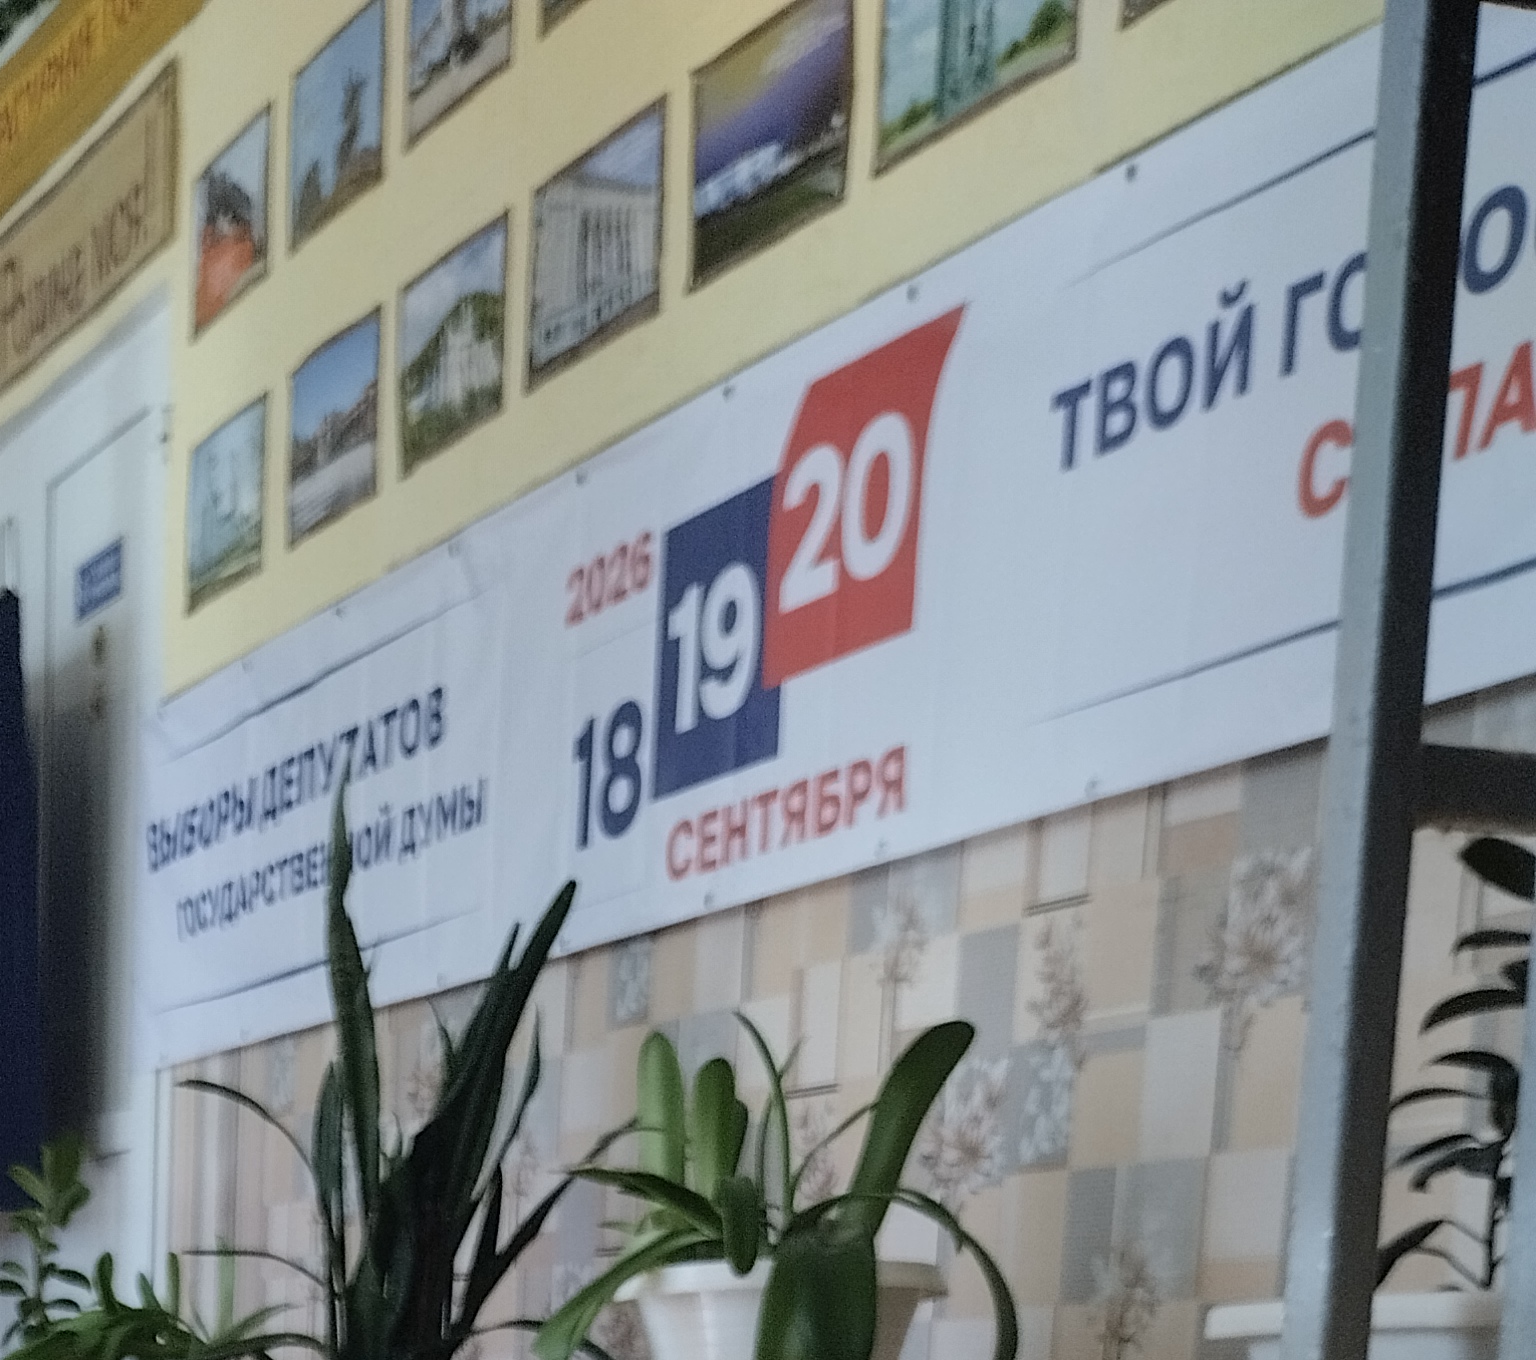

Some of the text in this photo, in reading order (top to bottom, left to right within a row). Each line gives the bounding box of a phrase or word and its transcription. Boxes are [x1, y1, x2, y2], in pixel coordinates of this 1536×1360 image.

[1051, 184, 1536, 474] ТВОЙ ГОО
[778, 411, 916, 615] 20
[1295, 340, 1536, 520] СЛА
[565, 530, 653, 626] 2026
[667, 562, 762, 734] 19
[146, 686, 446, 874] ВЫБОРЫ ДЕПУТАТОВ
[398, 777, 489, 866] ДУМЫ
[573, 700, 643, 850] 18
[667, 744, 908, 880] СЕНТЯБРЯ
